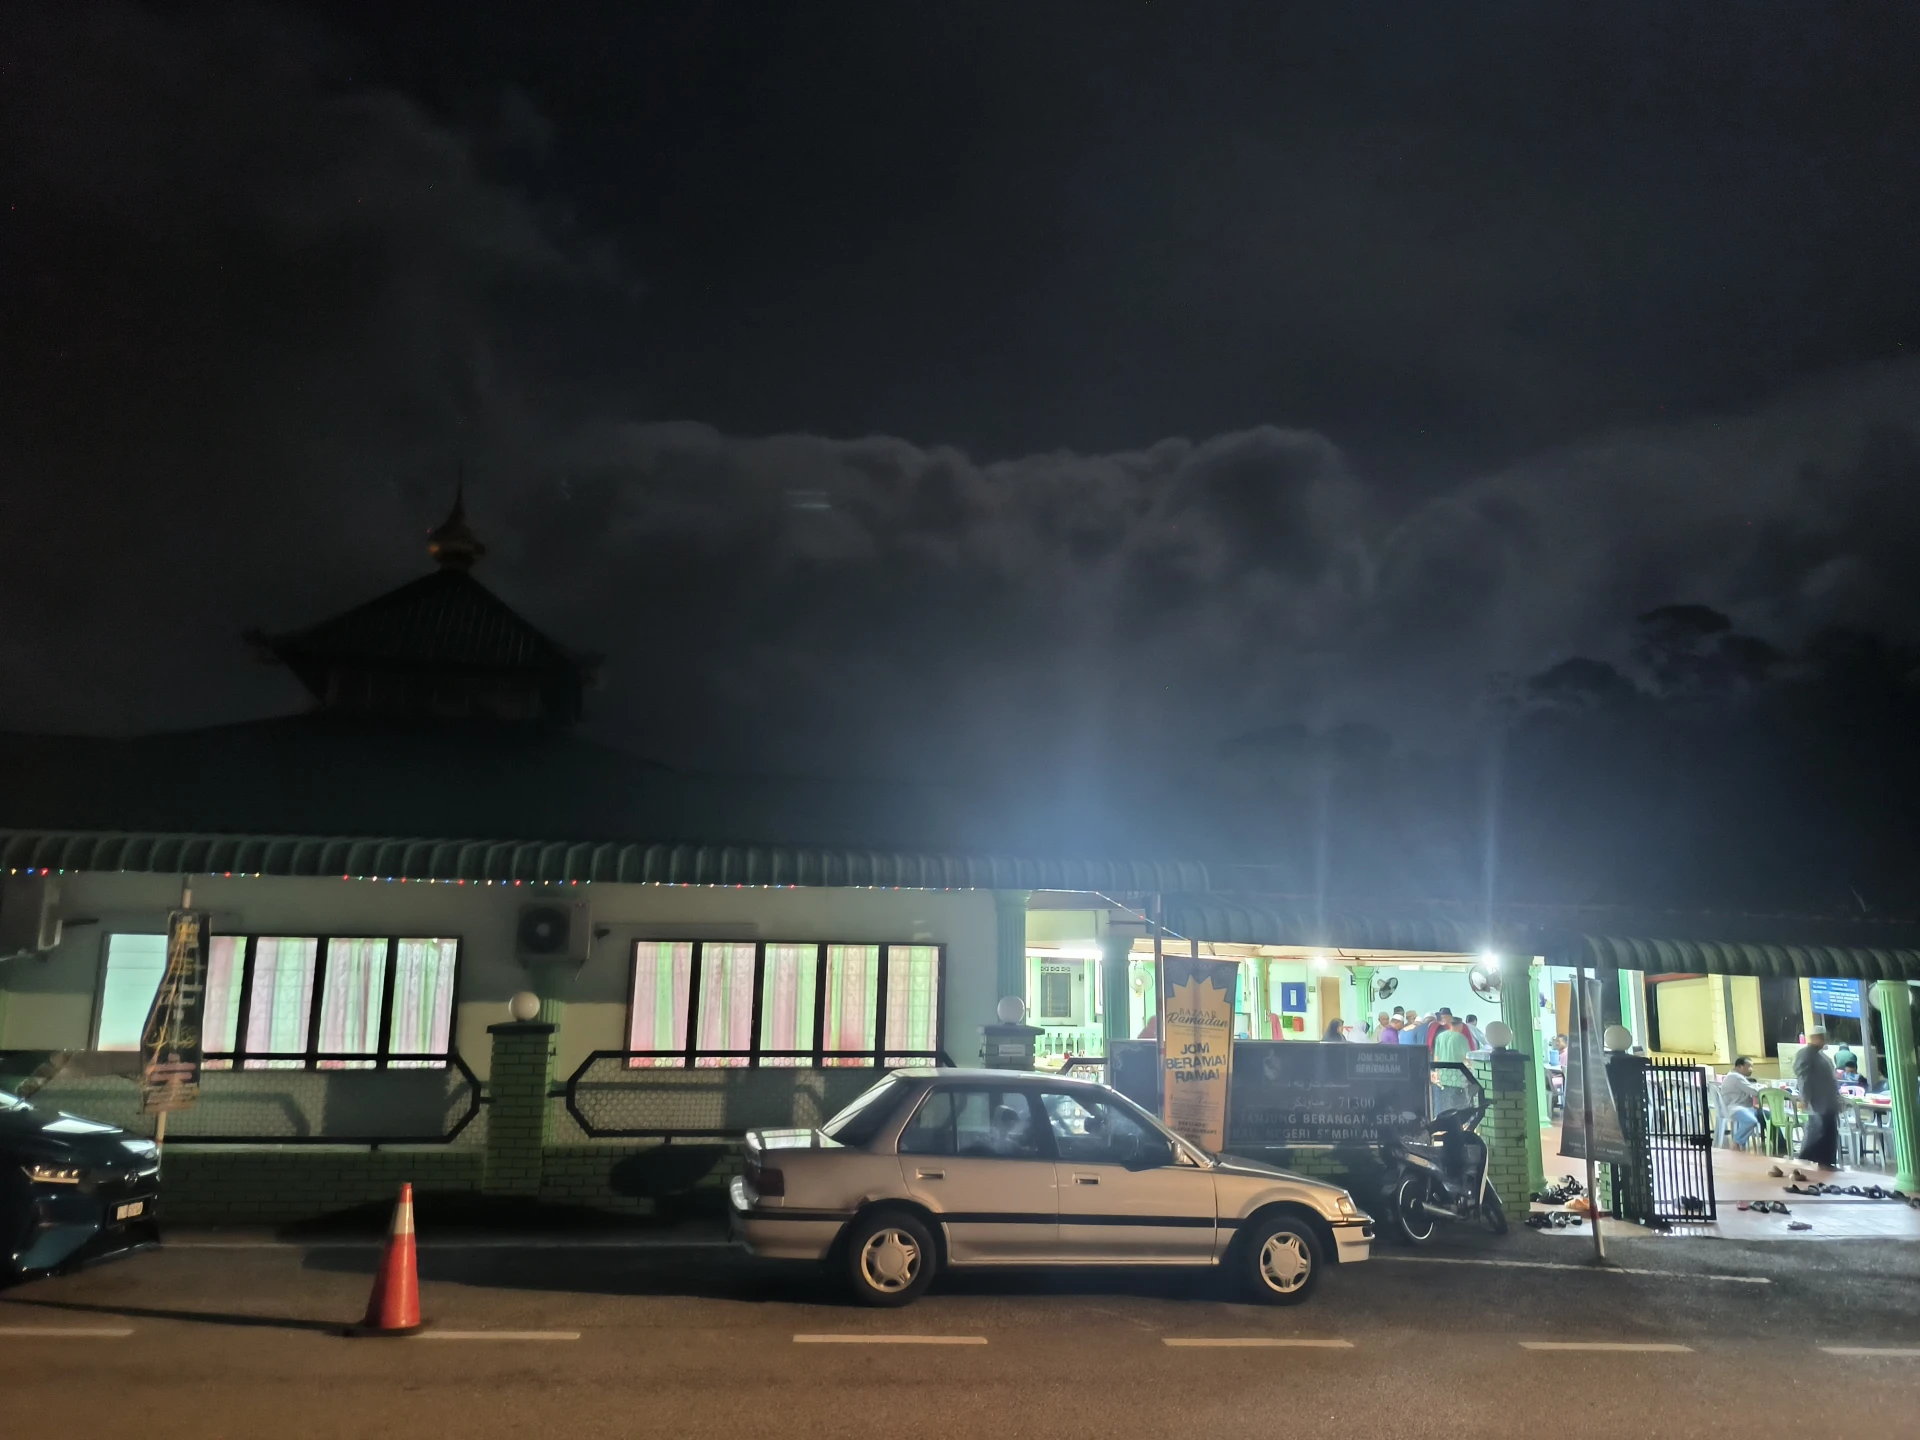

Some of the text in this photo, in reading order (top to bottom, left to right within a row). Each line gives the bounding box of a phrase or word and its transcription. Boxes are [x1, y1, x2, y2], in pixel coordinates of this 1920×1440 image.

[1167, 1012, 1229, 1027] Ramadan
[1180, 1008, 1218, 1019] BAZAAR
[1181, 1043, 1210, 1055] JOM
[1166, 1054, 1227, 1070] BERAMAI
[1357, 1052, 1399, 1063] JOM SOLAT
[1175, 1068, 1220, 1083] RAMAI
[1338, 1096, 1376, 1109] 71300
[1241, 1112, 1297, 1125] TANJUNG
